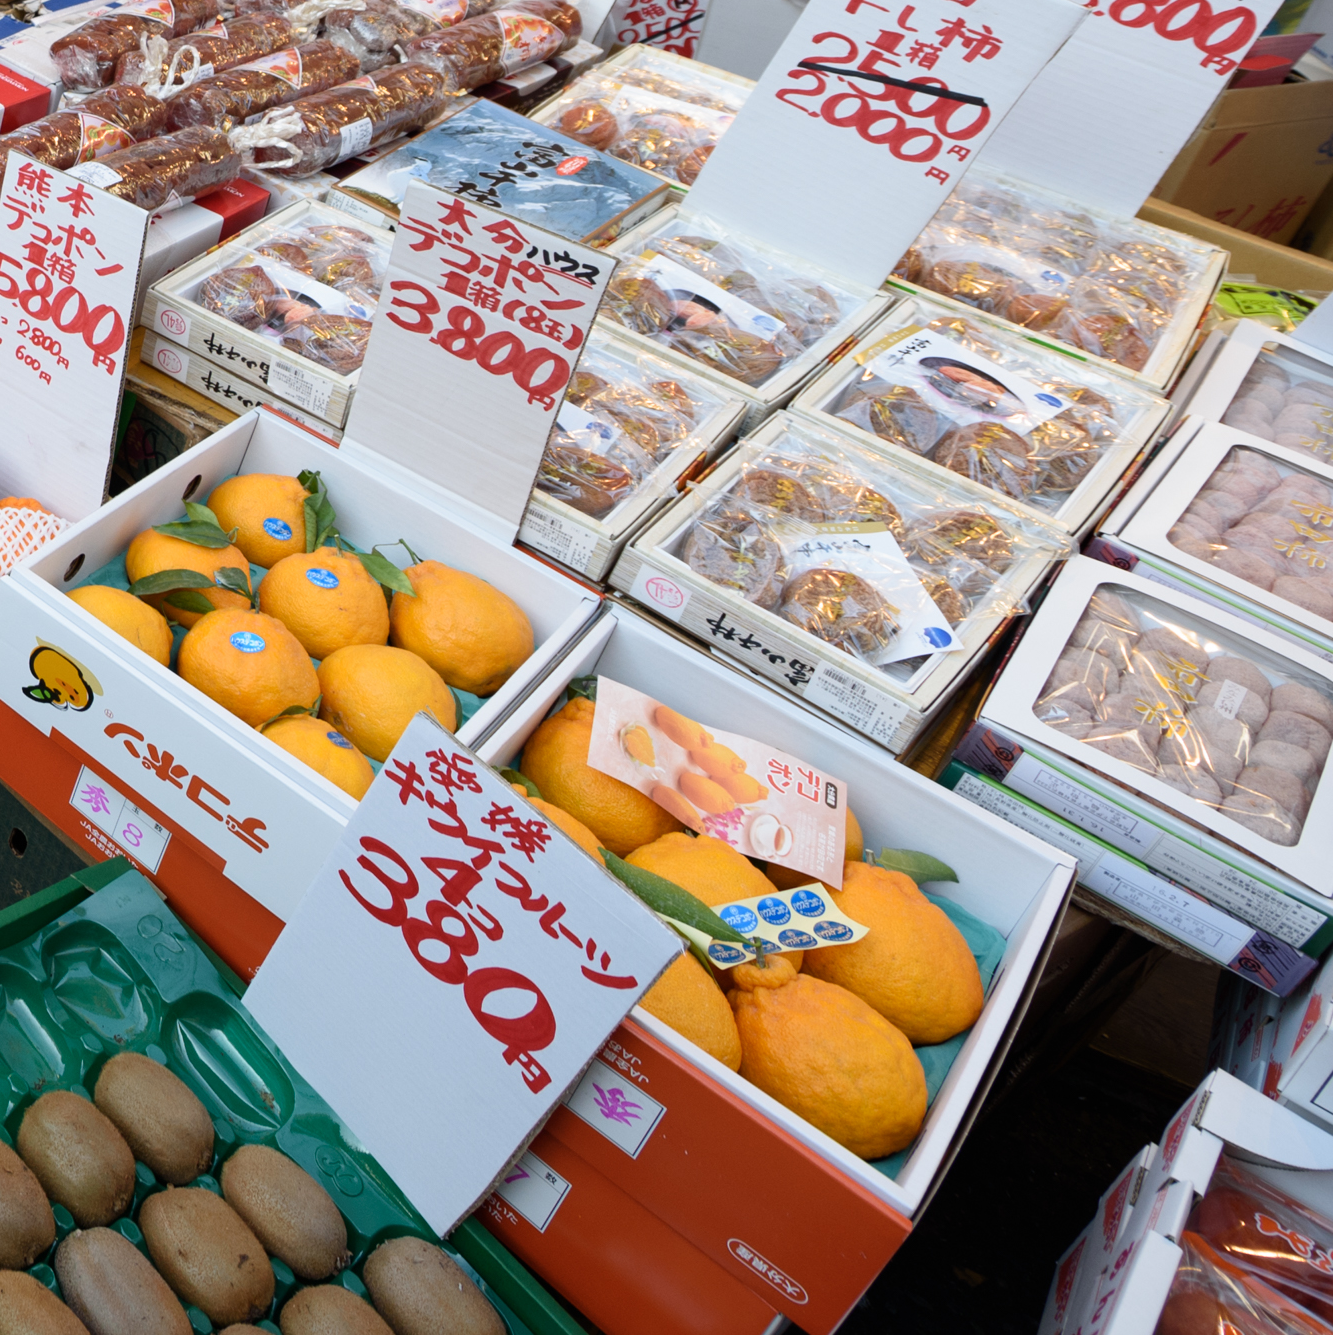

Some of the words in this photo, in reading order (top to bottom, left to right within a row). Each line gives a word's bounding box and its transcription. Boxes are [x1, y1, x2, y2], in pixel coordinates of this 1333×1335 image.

[865, 29, 944, 71] 1箱
[15, 162, 95, 219] 熊本
[2, 194, 124, 277] デコポン
[23, 241, 77, 285] 1箱
[398, 216, 587, 311] デコポン
[437, 198, 533, 255] 大分
[529, 246, 601, 285] ハウス
[15, 345, 52, 385] 600円
[80, 782, 111, 816] 秀
[103, 721, 271, 855] デコポン
[425, 748, 552, 864] 愛媛
[121, 822, 144, 849] 8
[385, 759, 639, 990] キウイフルーツ
[338, 836, 557, 1095] 380円
[591, 1082, 645, 1128] 秀
[735, 1243, 801, 1297] 大分県産
